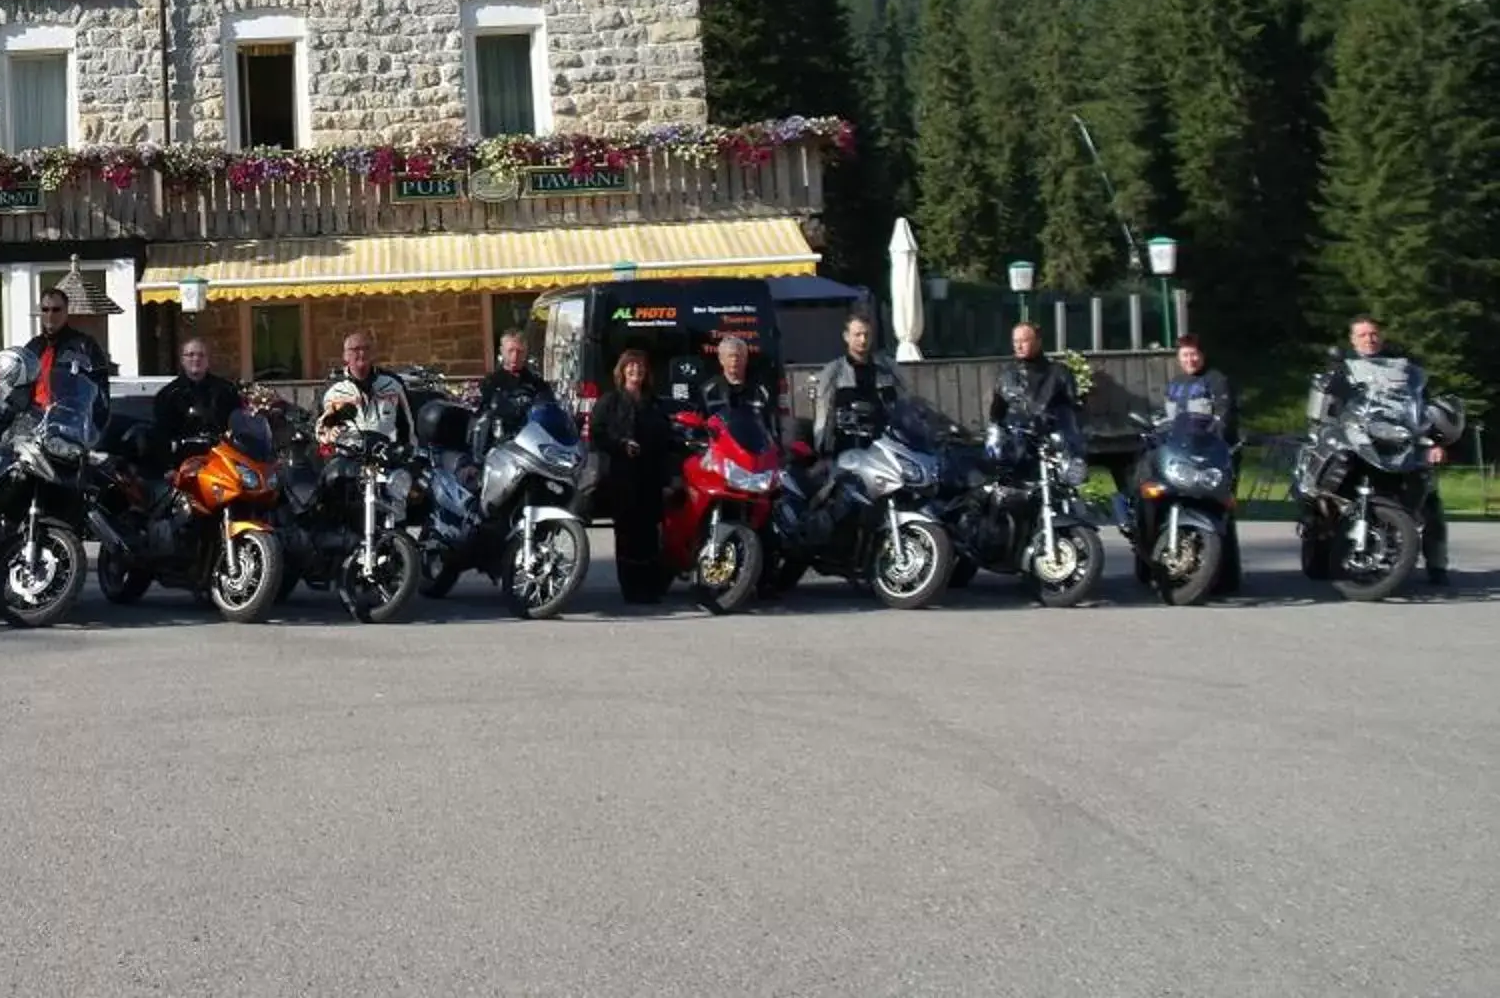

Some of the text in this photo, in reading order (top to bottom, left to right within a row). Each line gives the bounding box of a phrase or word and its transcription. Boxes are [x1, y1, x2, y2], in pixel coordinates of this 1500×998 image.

[402, 179, 451, 195] PUB
[537, 170, 625, 189] TAVERNE
[612, 307, 676, 319] AL MOTO
